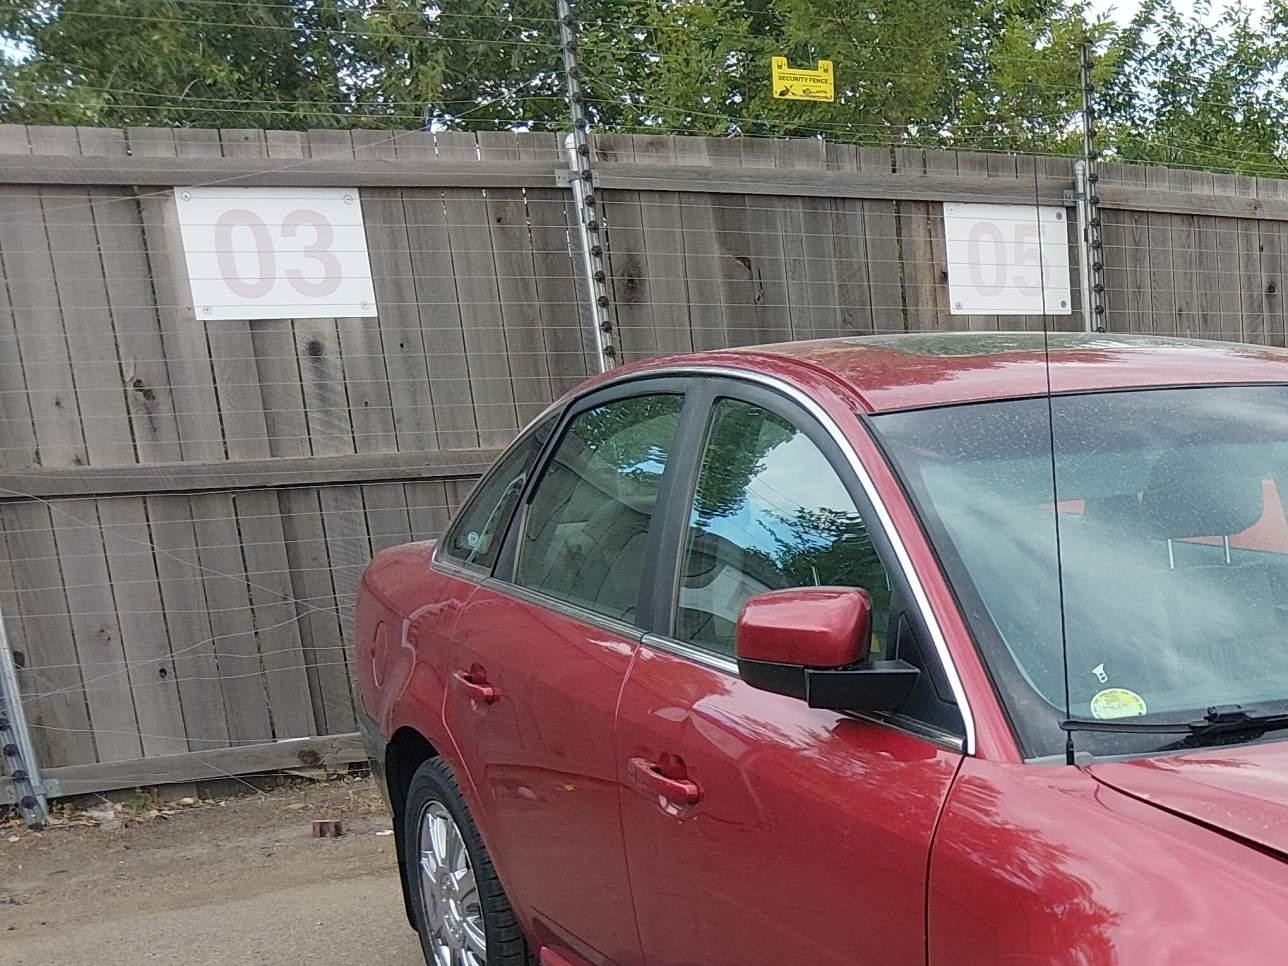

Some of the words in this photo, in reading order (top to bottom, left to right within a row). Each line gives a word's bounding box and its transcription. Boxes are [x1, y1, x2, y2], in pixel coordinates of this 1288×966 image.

[778, 75, 808, 83] SECURITY
[214, 208, 343, 299] 03
[967, 221, 1050, 297] 05
